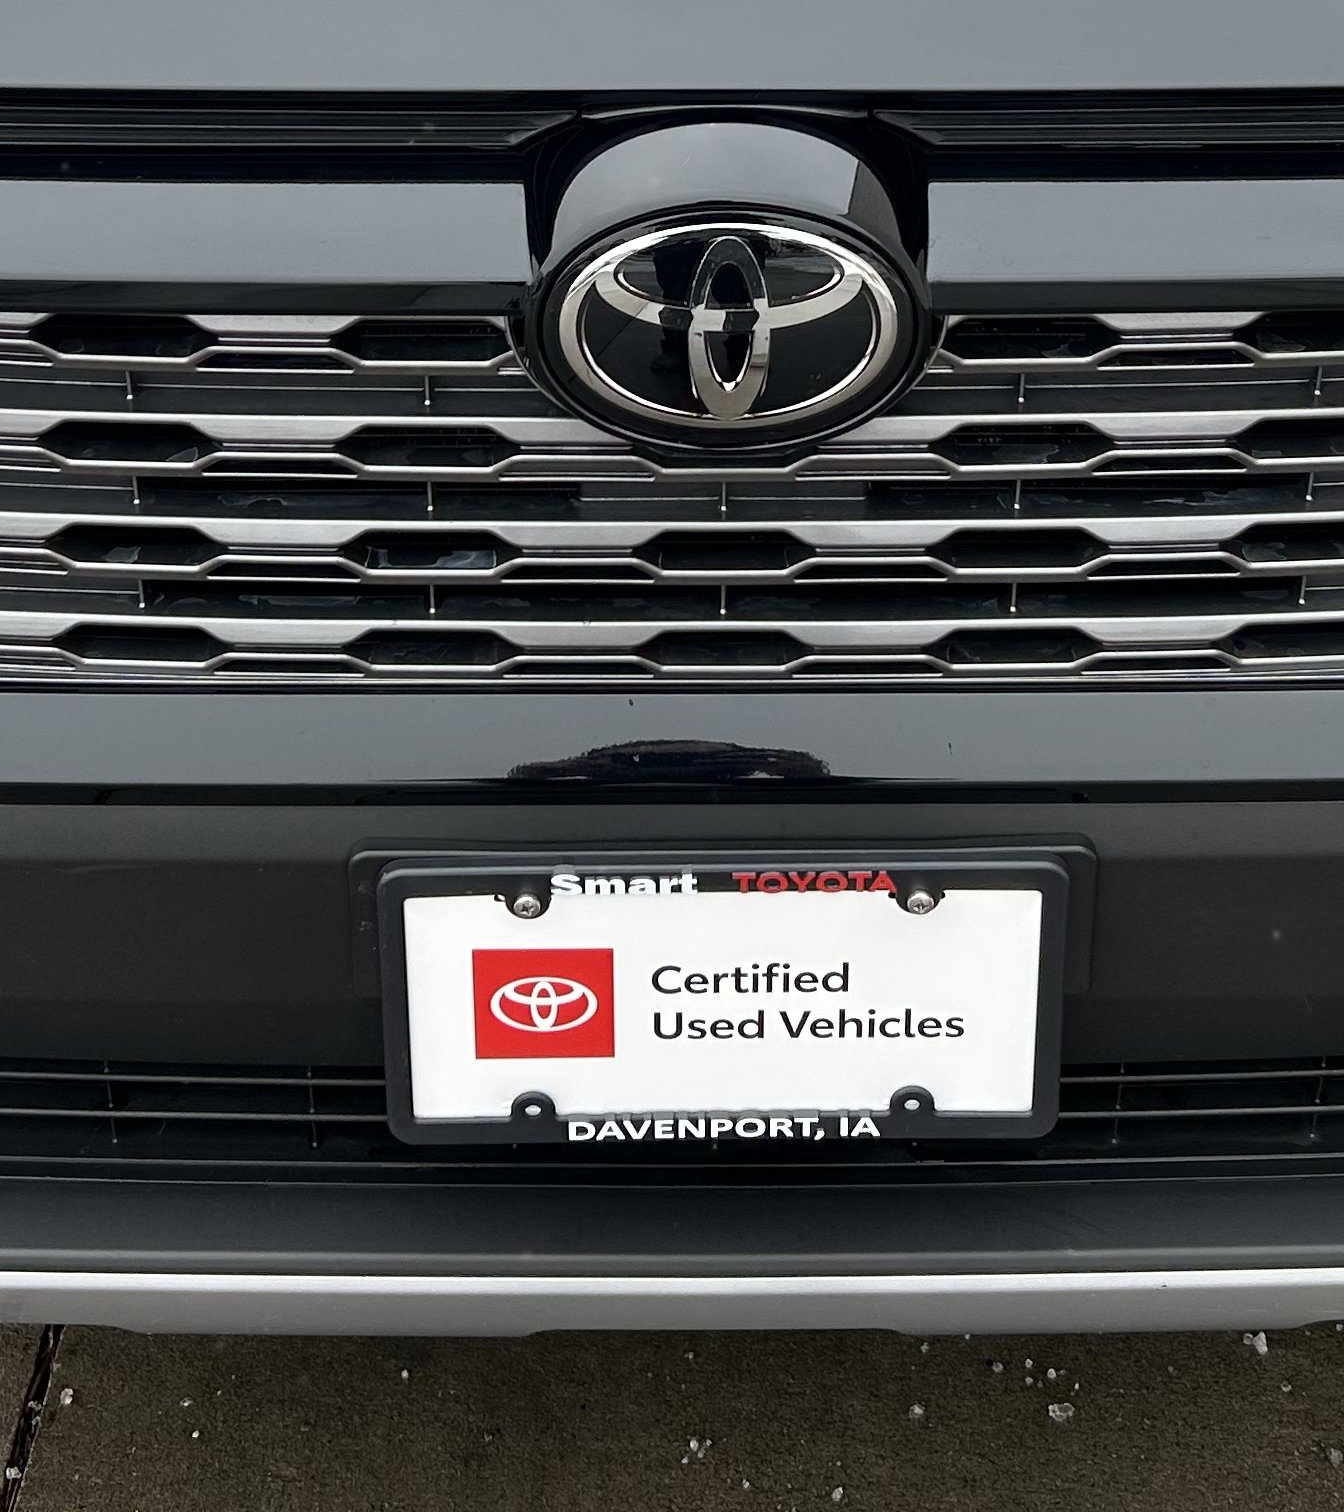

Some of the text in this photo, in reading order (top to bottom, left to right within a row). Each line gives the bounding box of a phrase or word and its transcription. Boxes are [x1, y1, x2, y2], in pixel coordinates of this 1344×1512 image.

[550, 870, 898, 896] Smart TOYOTA
[651, 961, 850, 995] Certified
[653, 1008, 965, 1040] Used Vehicles
[568, 1117, 881, 1141] DAVENPORT, IA
